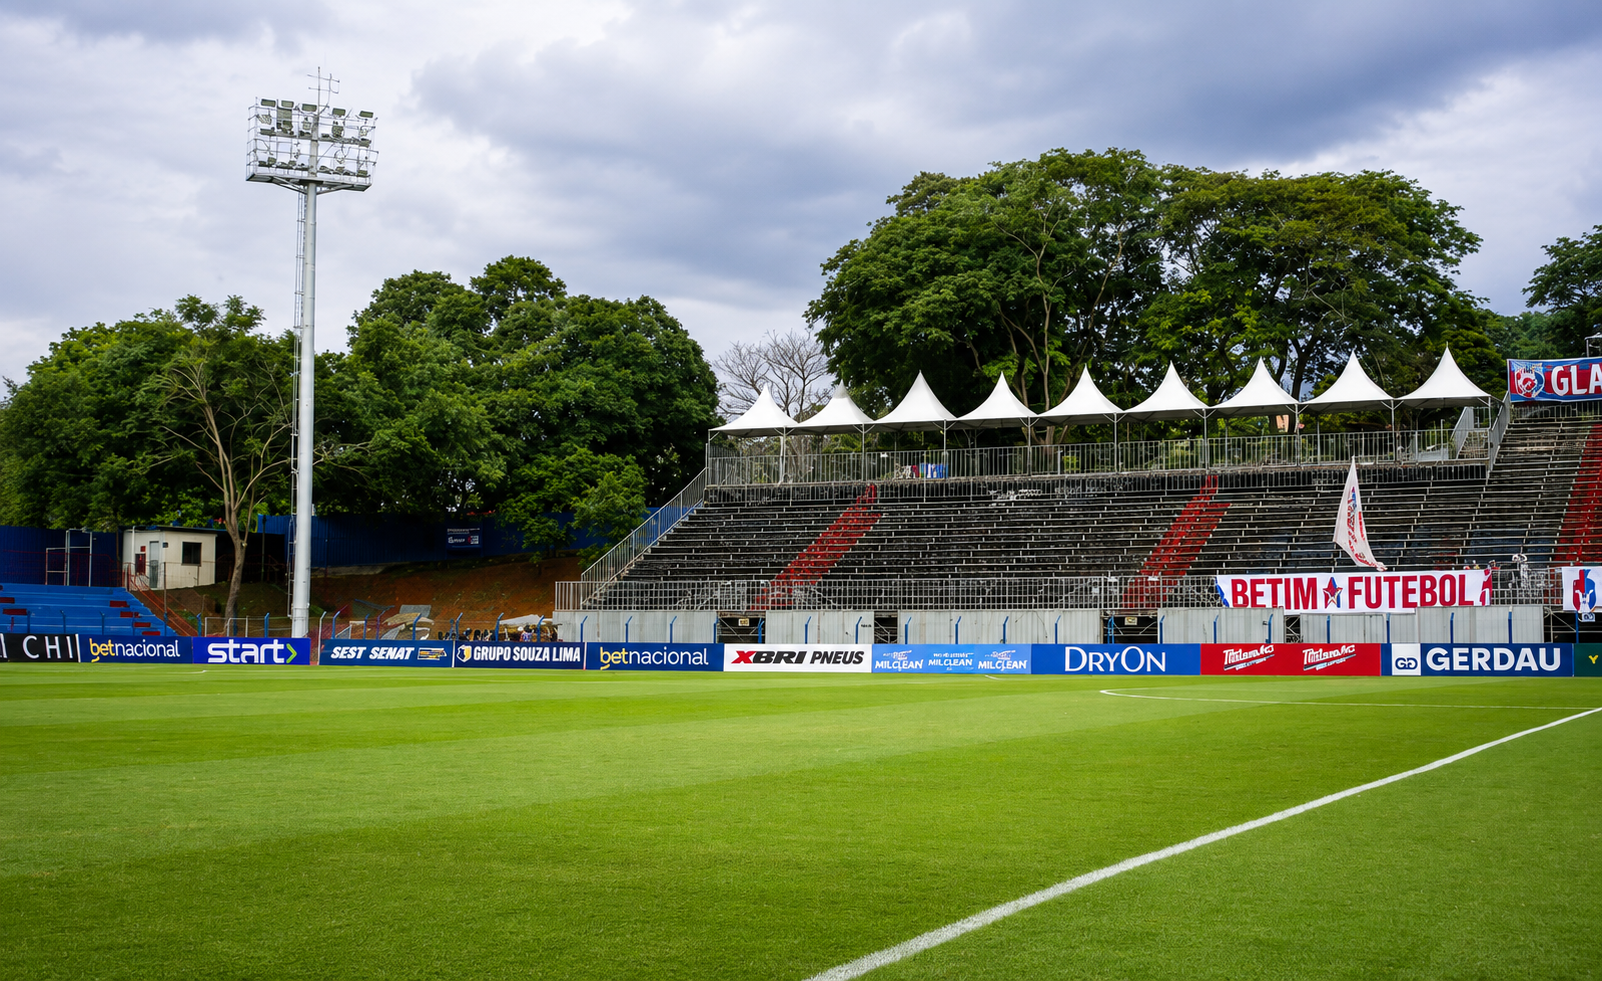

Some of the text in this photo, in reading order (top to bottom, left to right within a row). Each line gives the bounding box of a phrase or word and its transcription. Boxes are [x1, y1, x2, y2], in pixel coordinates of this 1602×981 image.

[1231, 574, 1474, 610] BETIM FUTEBOL
[89, 638, 181, 658] betnacional
[331, 646, 366, 659] SEST
[369, 647, 415, 660] SENAT
[473, 646, 581, 662] GRUPO SOUZA LIMA
[600, 646, 709, 666] betnacional
[731, 650, 808, 665] XBRI
[810, 651, 865, 665] PNEUS
[928, 658, 973, 667] MILCLEAN
[1426, 647, 1561, 671] GERDAU
[875, 659, 924, 670] MILCLEAN
[978, 659, 1028, 670] MILCLEAN
